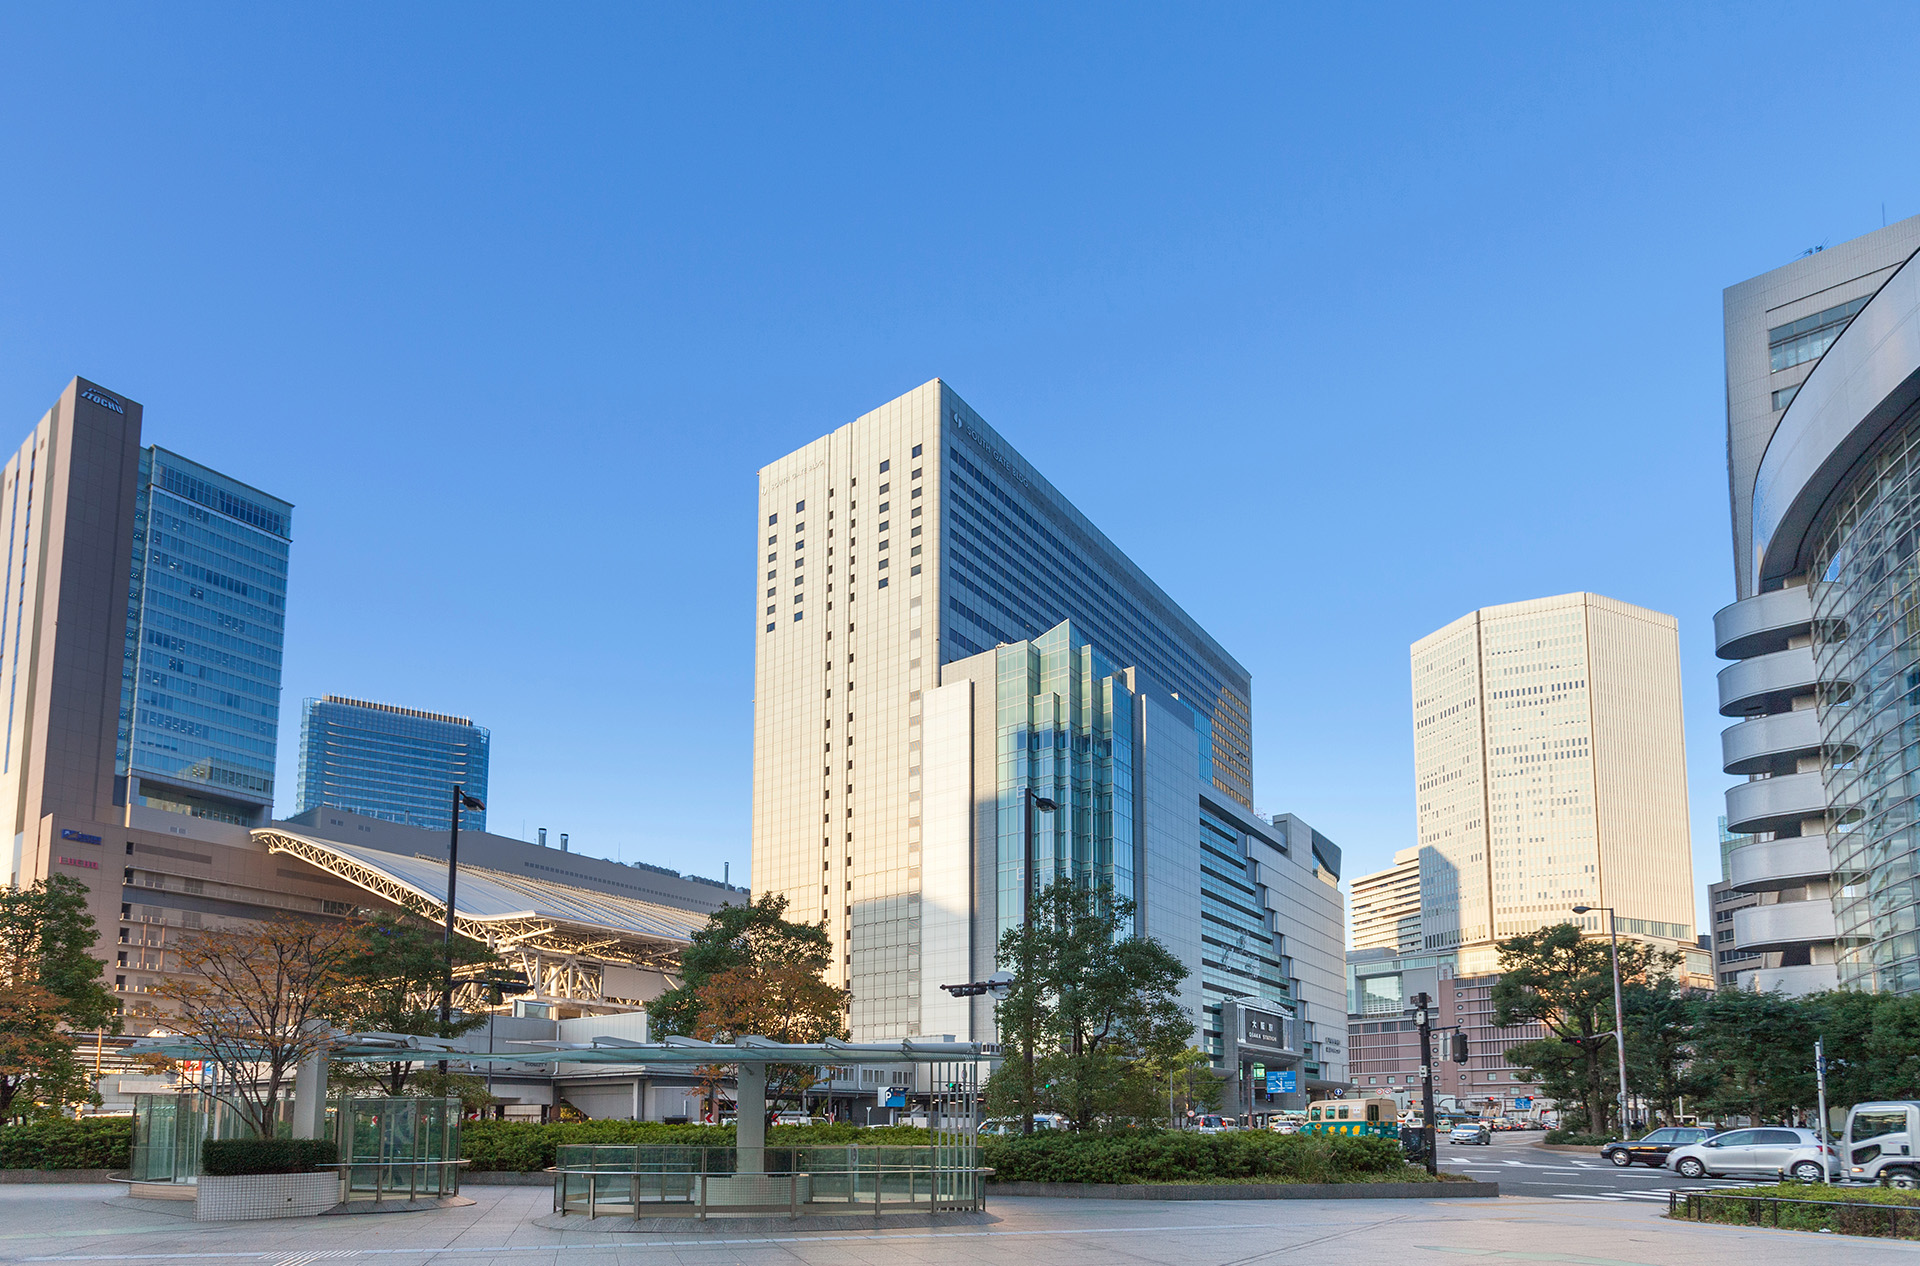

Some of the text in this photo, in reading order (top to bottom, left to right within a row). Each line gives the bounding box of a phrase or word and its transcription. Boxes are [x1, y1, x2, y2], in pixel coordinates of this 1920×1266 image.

[81, 390, 124, 415] ITOCHU
[966, 425, 1029, 489] SOUTH GATE BLDG
[1248, 1031, 1262, 1039] OSAKA
